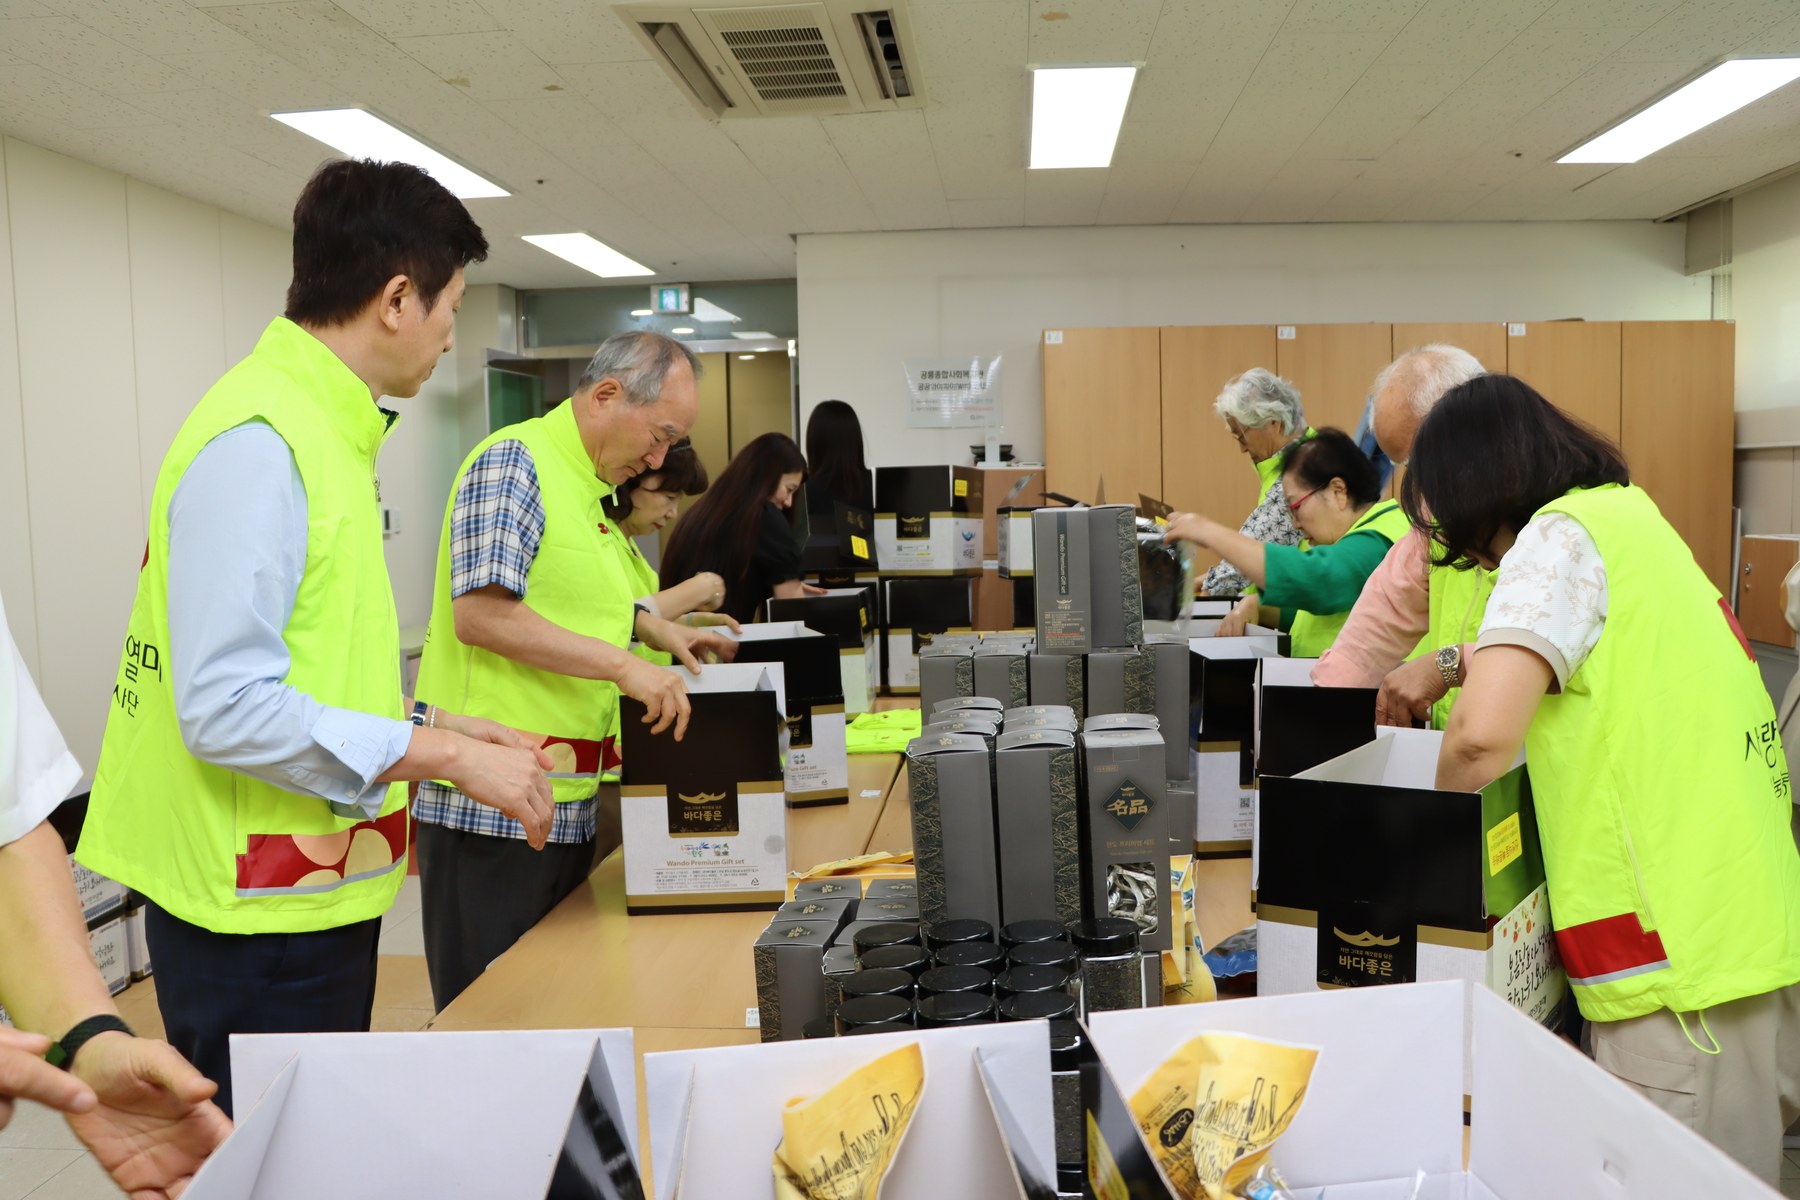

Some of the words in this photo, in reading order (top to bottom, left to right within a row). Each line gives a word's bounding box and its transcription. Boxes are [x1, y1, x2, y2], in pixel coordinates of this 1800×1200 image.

[1745, 719, 1777, 768] 사랑
[683, 810, 722, 822] 바다좋은
[1106, 799, 1148, 816] 名品
[1338, 955, 1393, 977] 바다좋은
